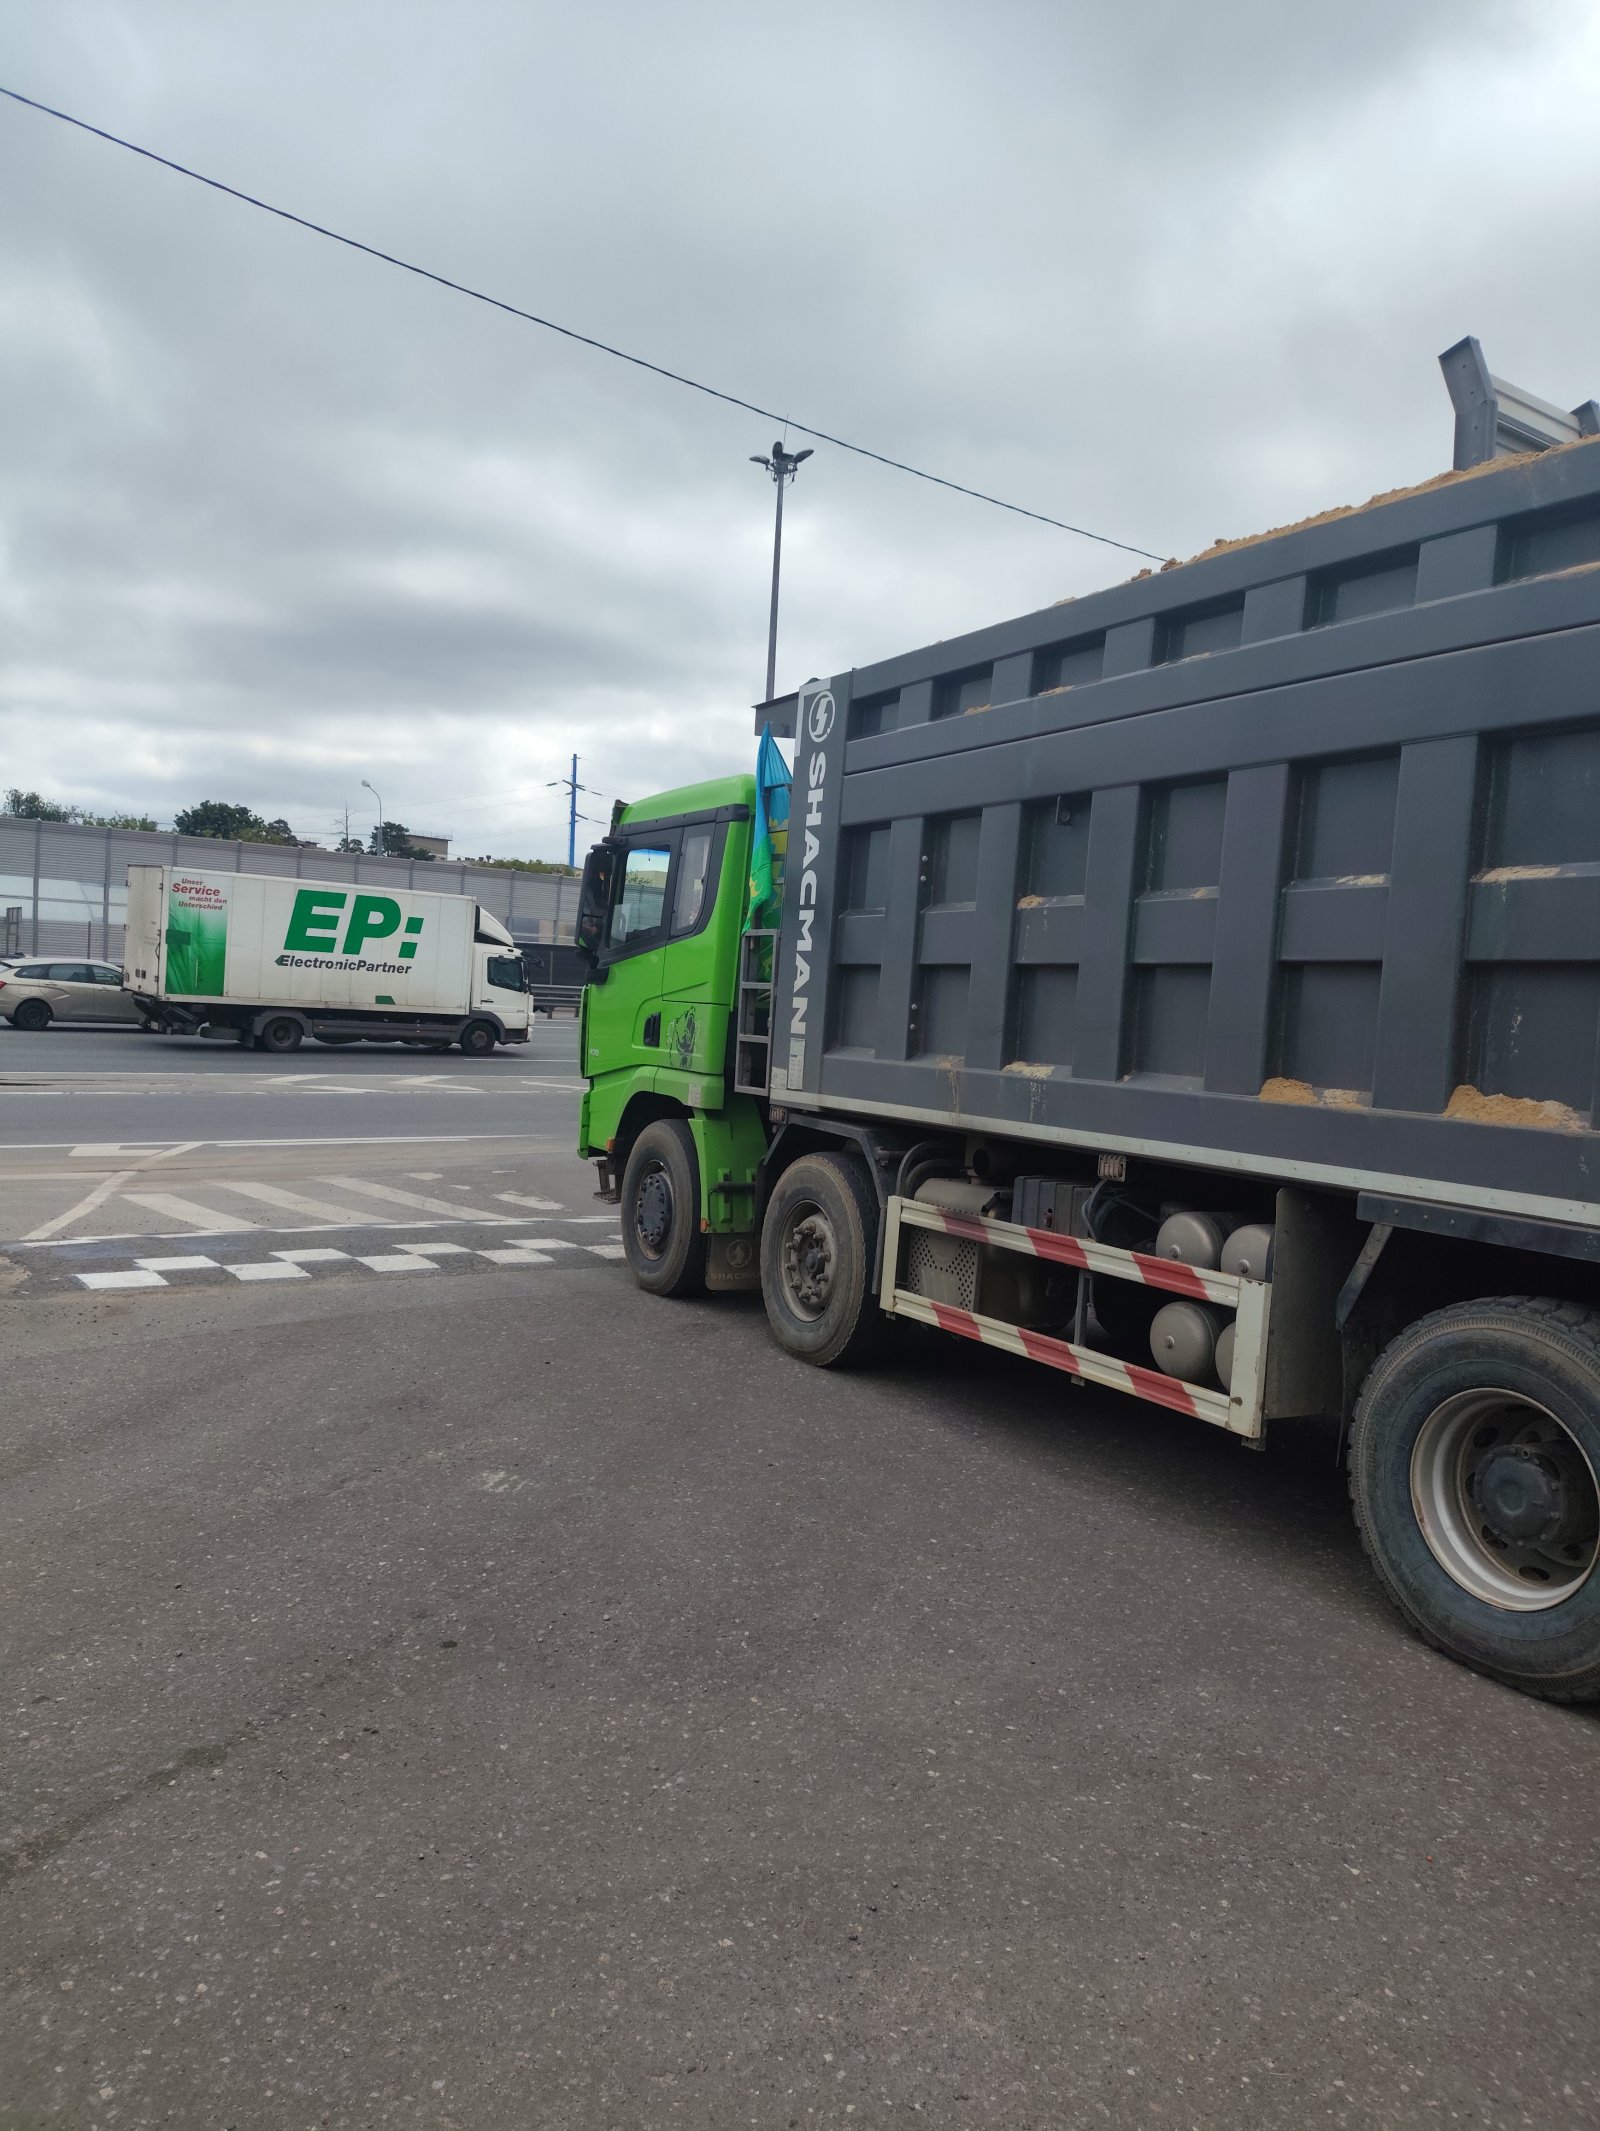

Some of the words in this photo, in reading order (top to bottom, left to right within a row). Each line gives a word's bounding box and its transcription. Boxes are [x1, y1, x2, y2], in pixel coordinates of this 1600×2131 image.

[171, 882, 221, 897] Service
[181, 878, 203, 886] Unser
[790, 752, 826, 1035] SHACMAN
[178, 900, 223, 911] Unterschied
[283, 889, 424, 959] EP:
[277, 954, 412, 974] ElectronicPartner
